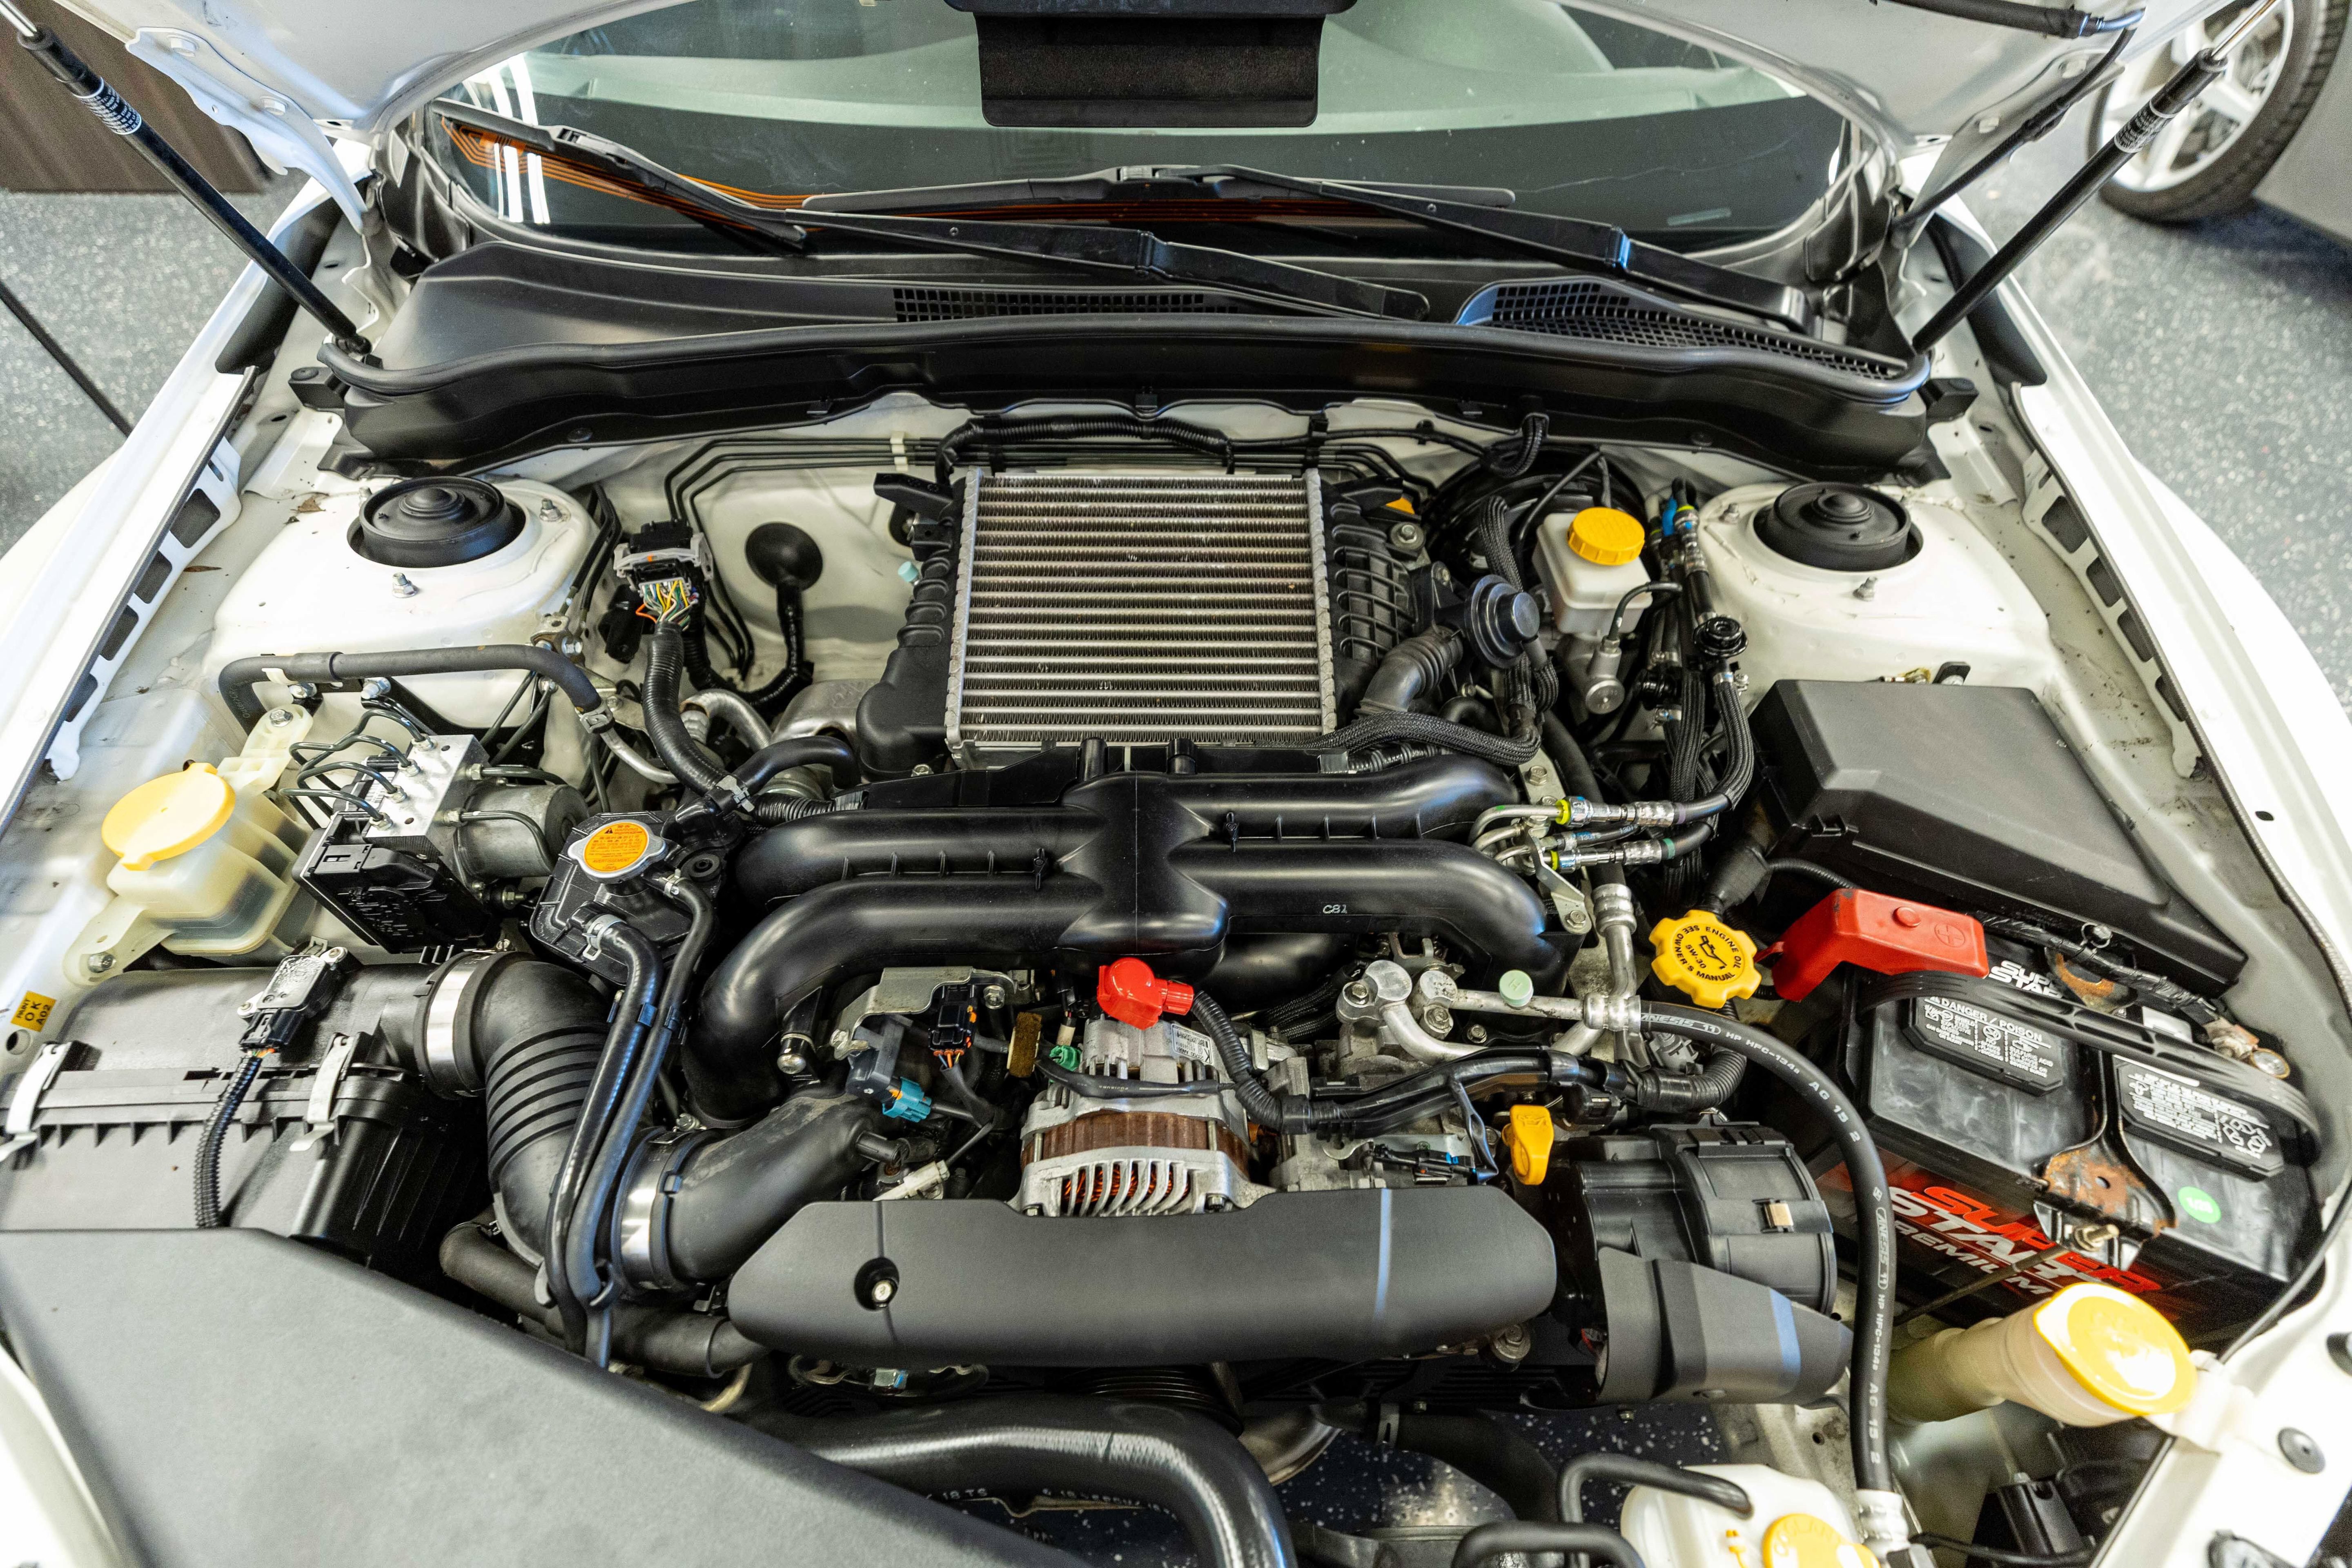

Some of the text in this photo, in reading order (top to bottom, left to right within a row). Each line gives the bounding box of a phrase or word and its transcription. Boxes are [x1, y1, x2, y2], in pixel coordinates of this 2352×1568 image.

[1674, 925, 1735, 981] SEE OWNER'S MANUAL
[1686, 944, 1707, 969] 5W-30
[1706, 926, 1742, 969] ENGINE OIL
[16, 998, 31, 1018] PAINT
[36, 1004, 51, 1025] A02
[1941, 998, 1988, 1022] DANGER
[1999, 1020, 2043, 1042] POISON
[1725, 1032, 1742, 1042] HP
[1745, 1039, 1801, 1075] HFC-134a
[1808, 1080, 1831, 1101] AG
[1833, 1104, 1849, 1124] 15
[1849, 1131, 1861, 1143] 2
[1895, 1219, 2054, 1295] REMIUM
[1878, 1294, 1886, 1310] HP
[1872, 1314, 1884, 1371] HFC-134a
[1869, 1381, 1879, 1408] AG
[1869, 1418, 1879, 1440] 15
[1870, 1451, 1881, 1464] 2
